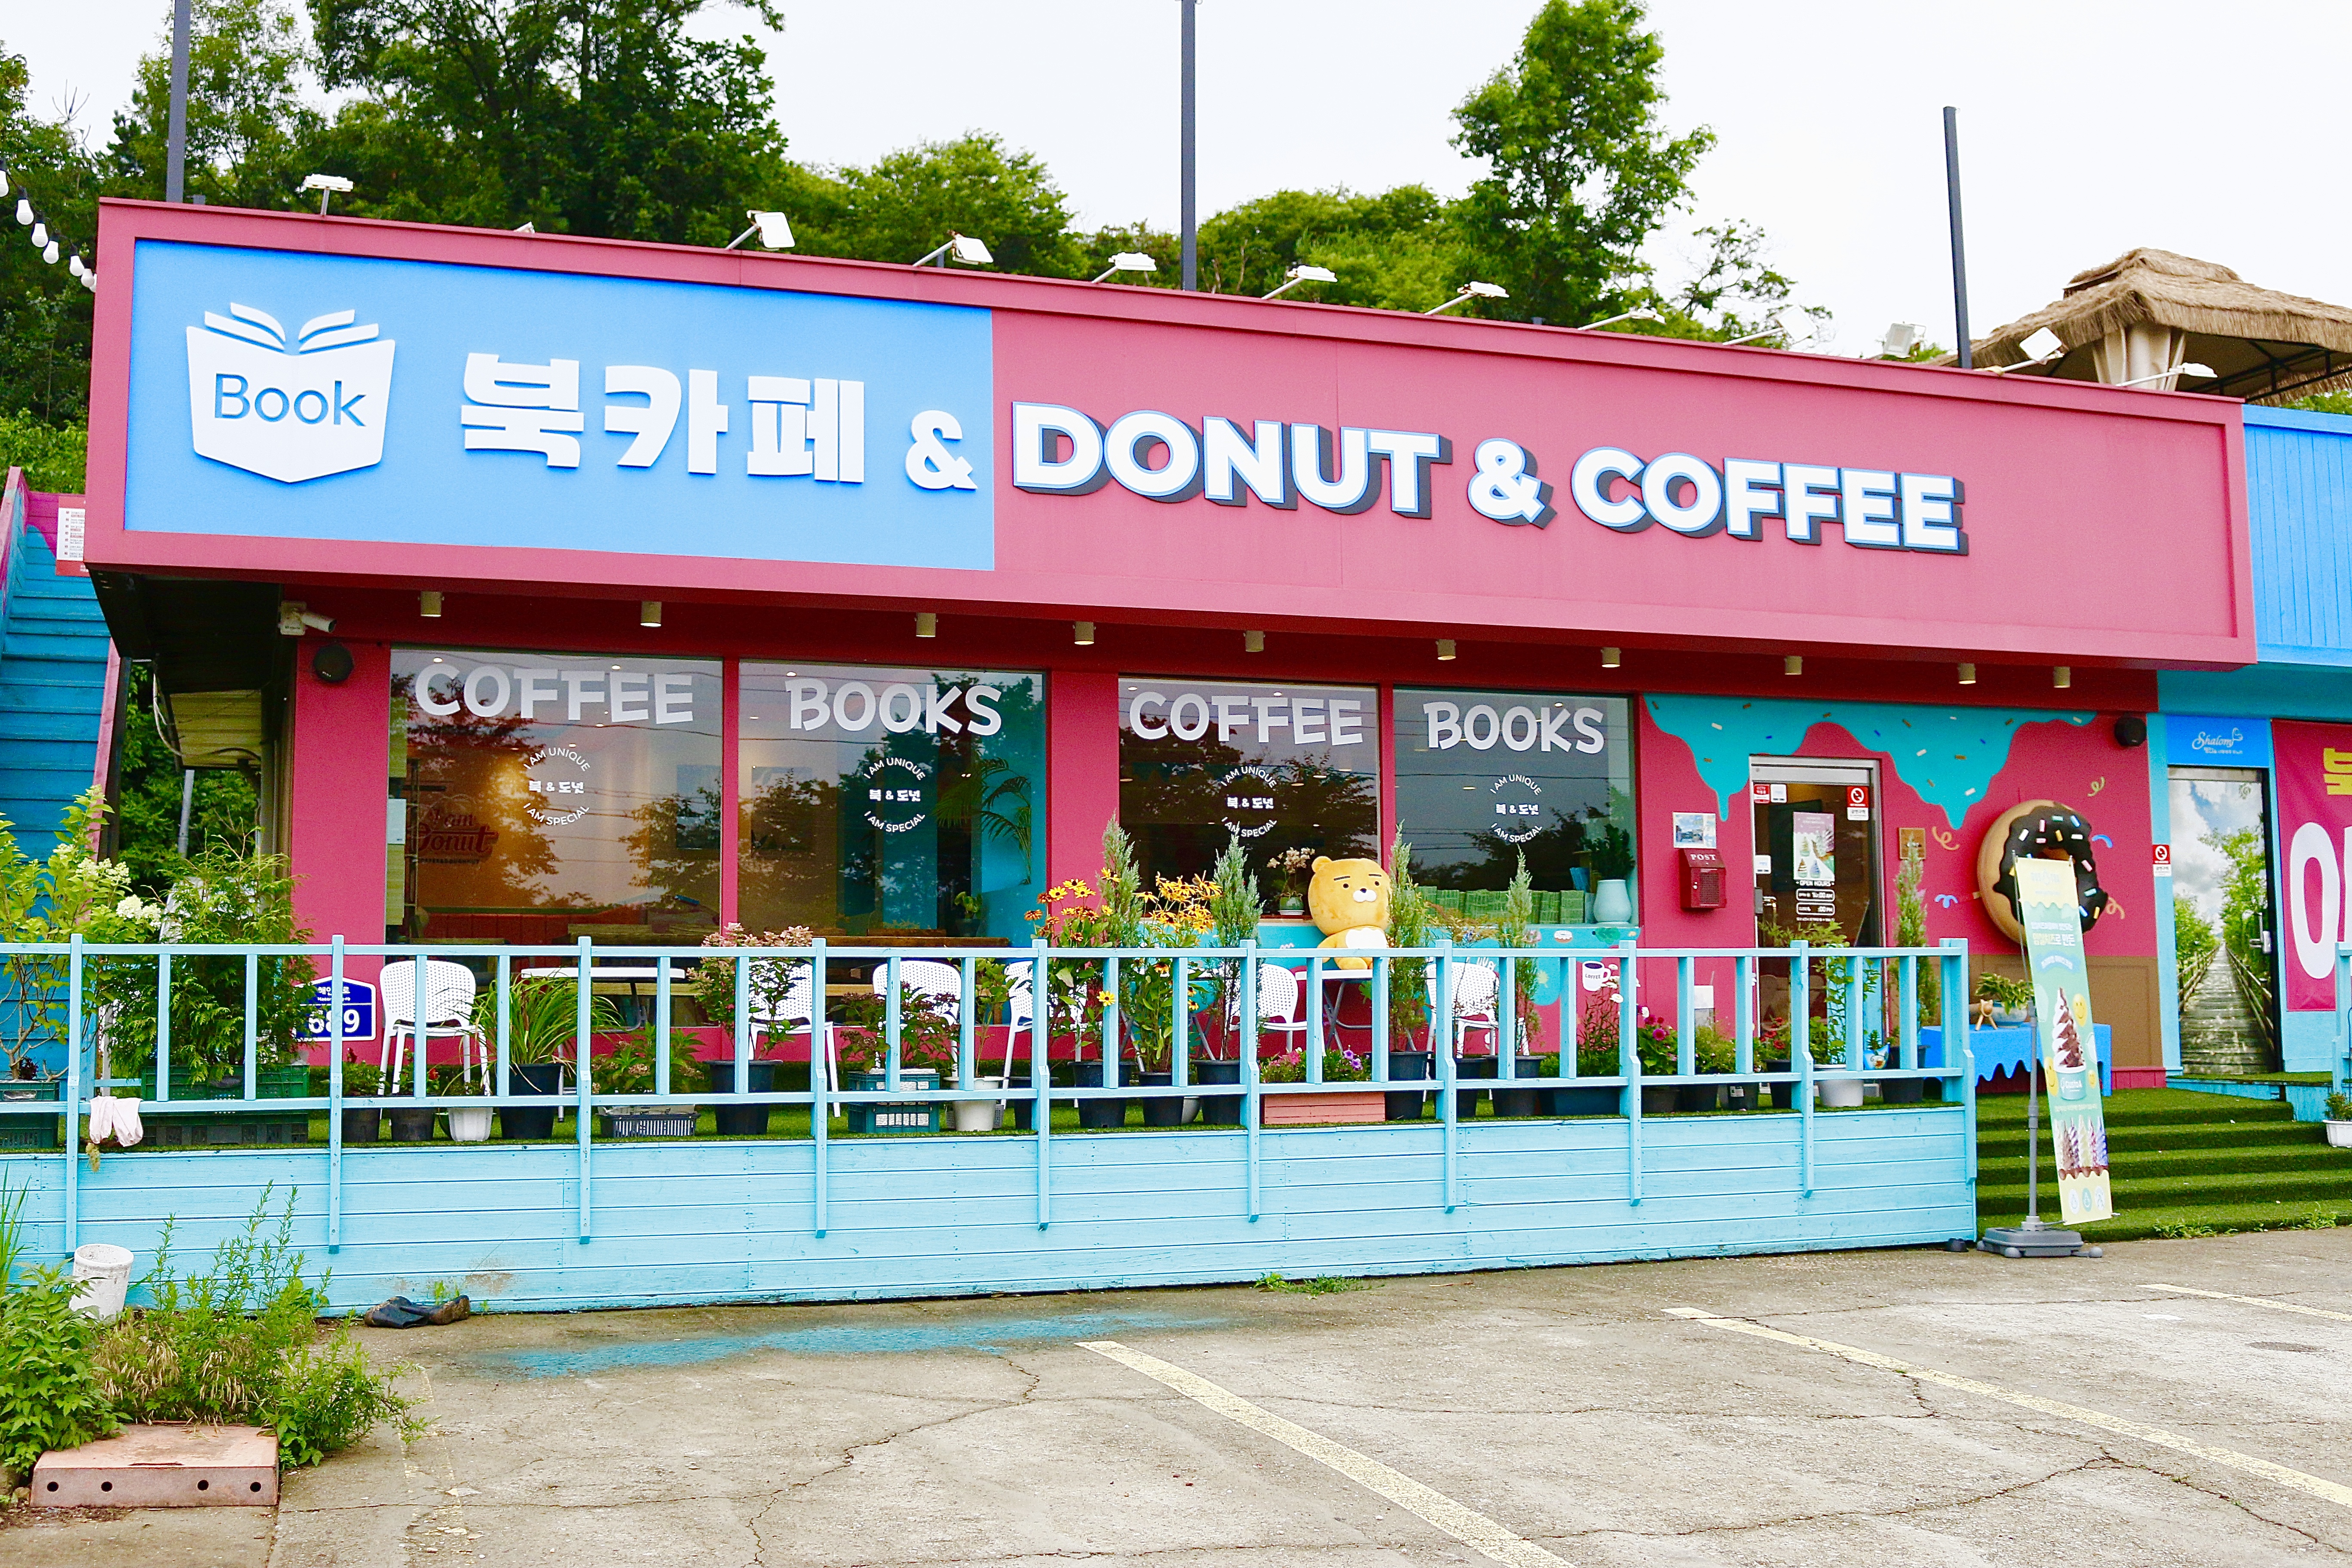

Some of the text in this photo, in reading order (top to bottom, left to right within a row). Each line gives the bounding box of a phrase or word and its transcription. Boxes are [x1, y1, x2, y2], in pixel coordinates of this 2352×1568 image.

[215, 373, 367, 427] Book
[461, 352, 977, 490] 북카페 &
[1012, 401, 1969, 554] DONUT & COFFEE
[415, 663, 693, 724] COFFEE
[784, 678, 1002, 735] BOOKS
[1129, 692, 1363, 745] COFFEE
[1423, 701, 1605, 754] BOOKS
[530, 750, 546, 766] AM
[548, 747, 591, 772] UNIQUE
[869, 760, 885, 775] AM
[886, 757, 926, 781] UNIQUE
[529, 781, 584, 794] 북 & 도넛
[1225, 769, 1240, 783] AM
[1241, 766, 1277, 788] UNIQUE
[1494, 776, 1508, 790] AM
[1508, 774, 1542, 795] UNIQUE
[870, 790, 921, 802] 북 & 도넛
[1227, 797, 1274, 809] 북 & 도넛
[527, 808, 545, 822] AM
[546, 806, 590, 825] SPECIAL
[1496, 803, 1539, 815] 북 & 도넛
[867, 816, 885, 830] AM
[885, 814, 925, 833] SPECIAL
[1225, 822, 1240, 836] AM
[1241, 819, 1277, 837] SPECIAL
[1494, 827, 1509, 840] AM
[1509, 825, 1543, 843] SPECIAL
